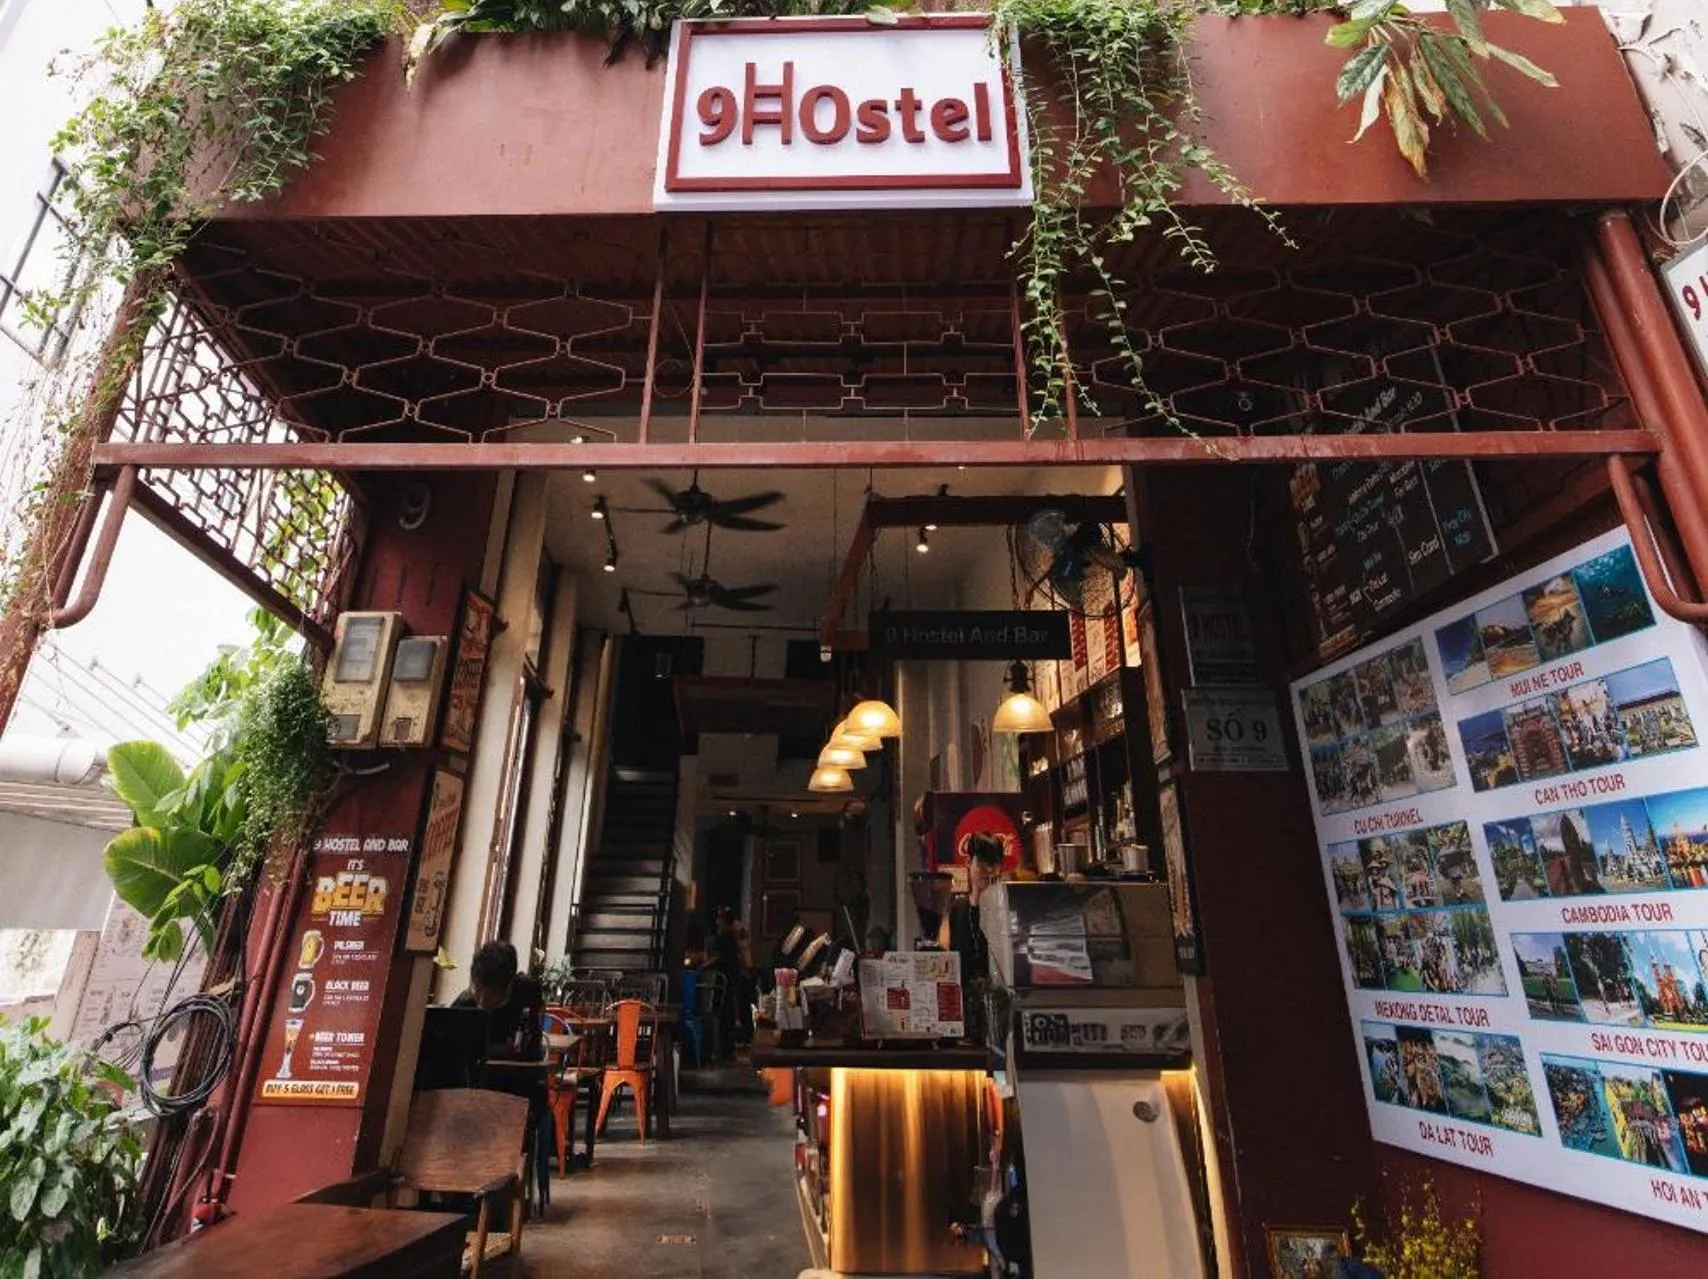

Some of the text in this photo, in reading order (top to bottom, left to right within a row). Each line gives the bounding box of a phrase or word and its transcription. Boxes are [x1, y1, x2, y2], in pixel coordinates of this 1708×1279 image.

[399, 483, 431, 532] 9
[1013, 626, 1049, 644] Bar
[1549, 662, 1584, 683] TOUR
[1252, 719, 1267, 743] 9
[1535, 773, 1625, 805] CAN THO TOUR
[322, 838, 361, 852] HOSTEL
[363, 838, 386, 852] AND
[387, 838, 409, 852] BAR
[312, 872, 386, 914] BEER
[328, 910, 361, 927] TIME
[1562, 903, 1674, 924] CAMBODIA TOUR
[1375, 1001, 1418, 1020] MEKONG
[1455, 1007, 1490, 1027] TOUR
[1591, 1032, 1613, 1052] SAI
[1615, 1035, 1644, 1055] GON
[1646, 1038, 1677, 1057] CITY
[1458, 1130, 1494, 1157] TOUR
[1680, 1186, 1702, 1210] AN
